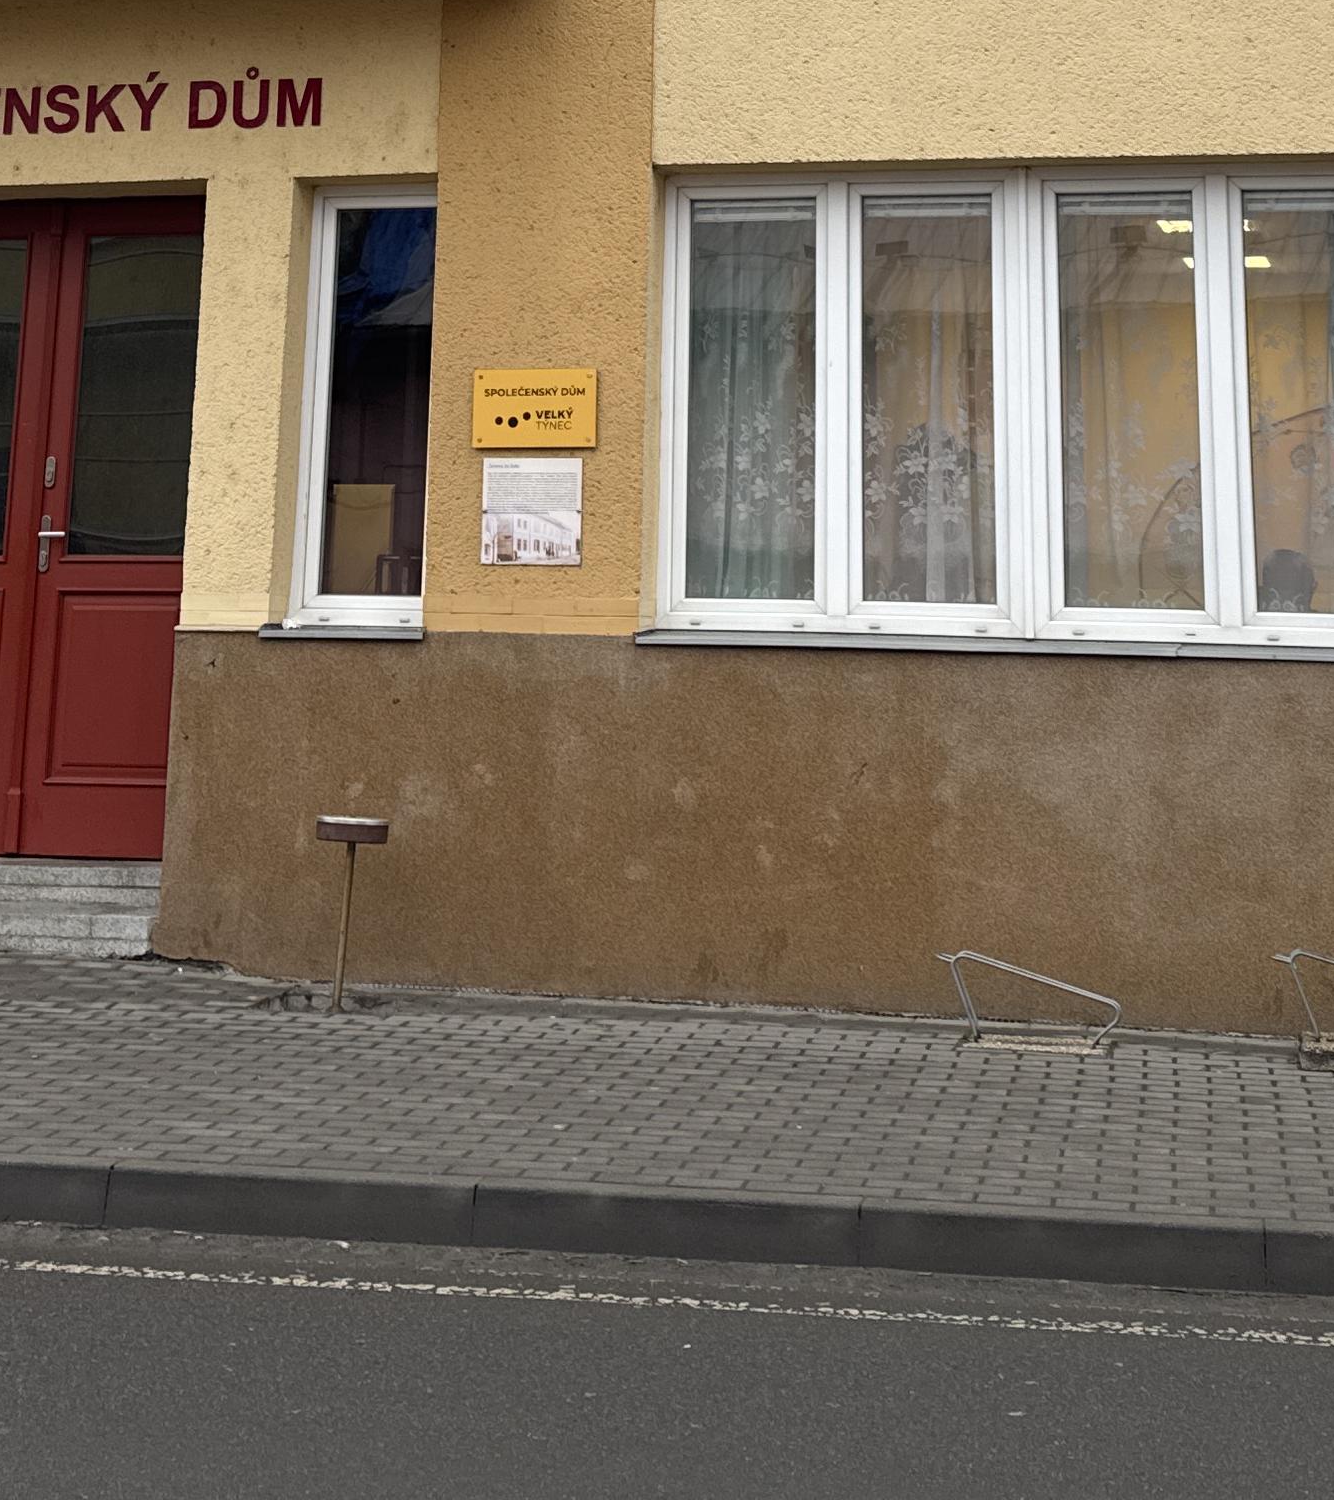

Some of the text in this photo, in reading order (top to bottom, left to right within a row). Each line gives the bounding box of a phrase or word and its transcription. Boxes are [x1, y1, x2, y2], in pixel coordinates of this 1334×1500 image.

[189, 66, 323, 130] DŮM
[484, 385, 586, 397] SPOLEČENSKÝ DŮM
[535, 407, 574, 420] VELKÝ
[535, 419, 573, 430] TÝNEC
